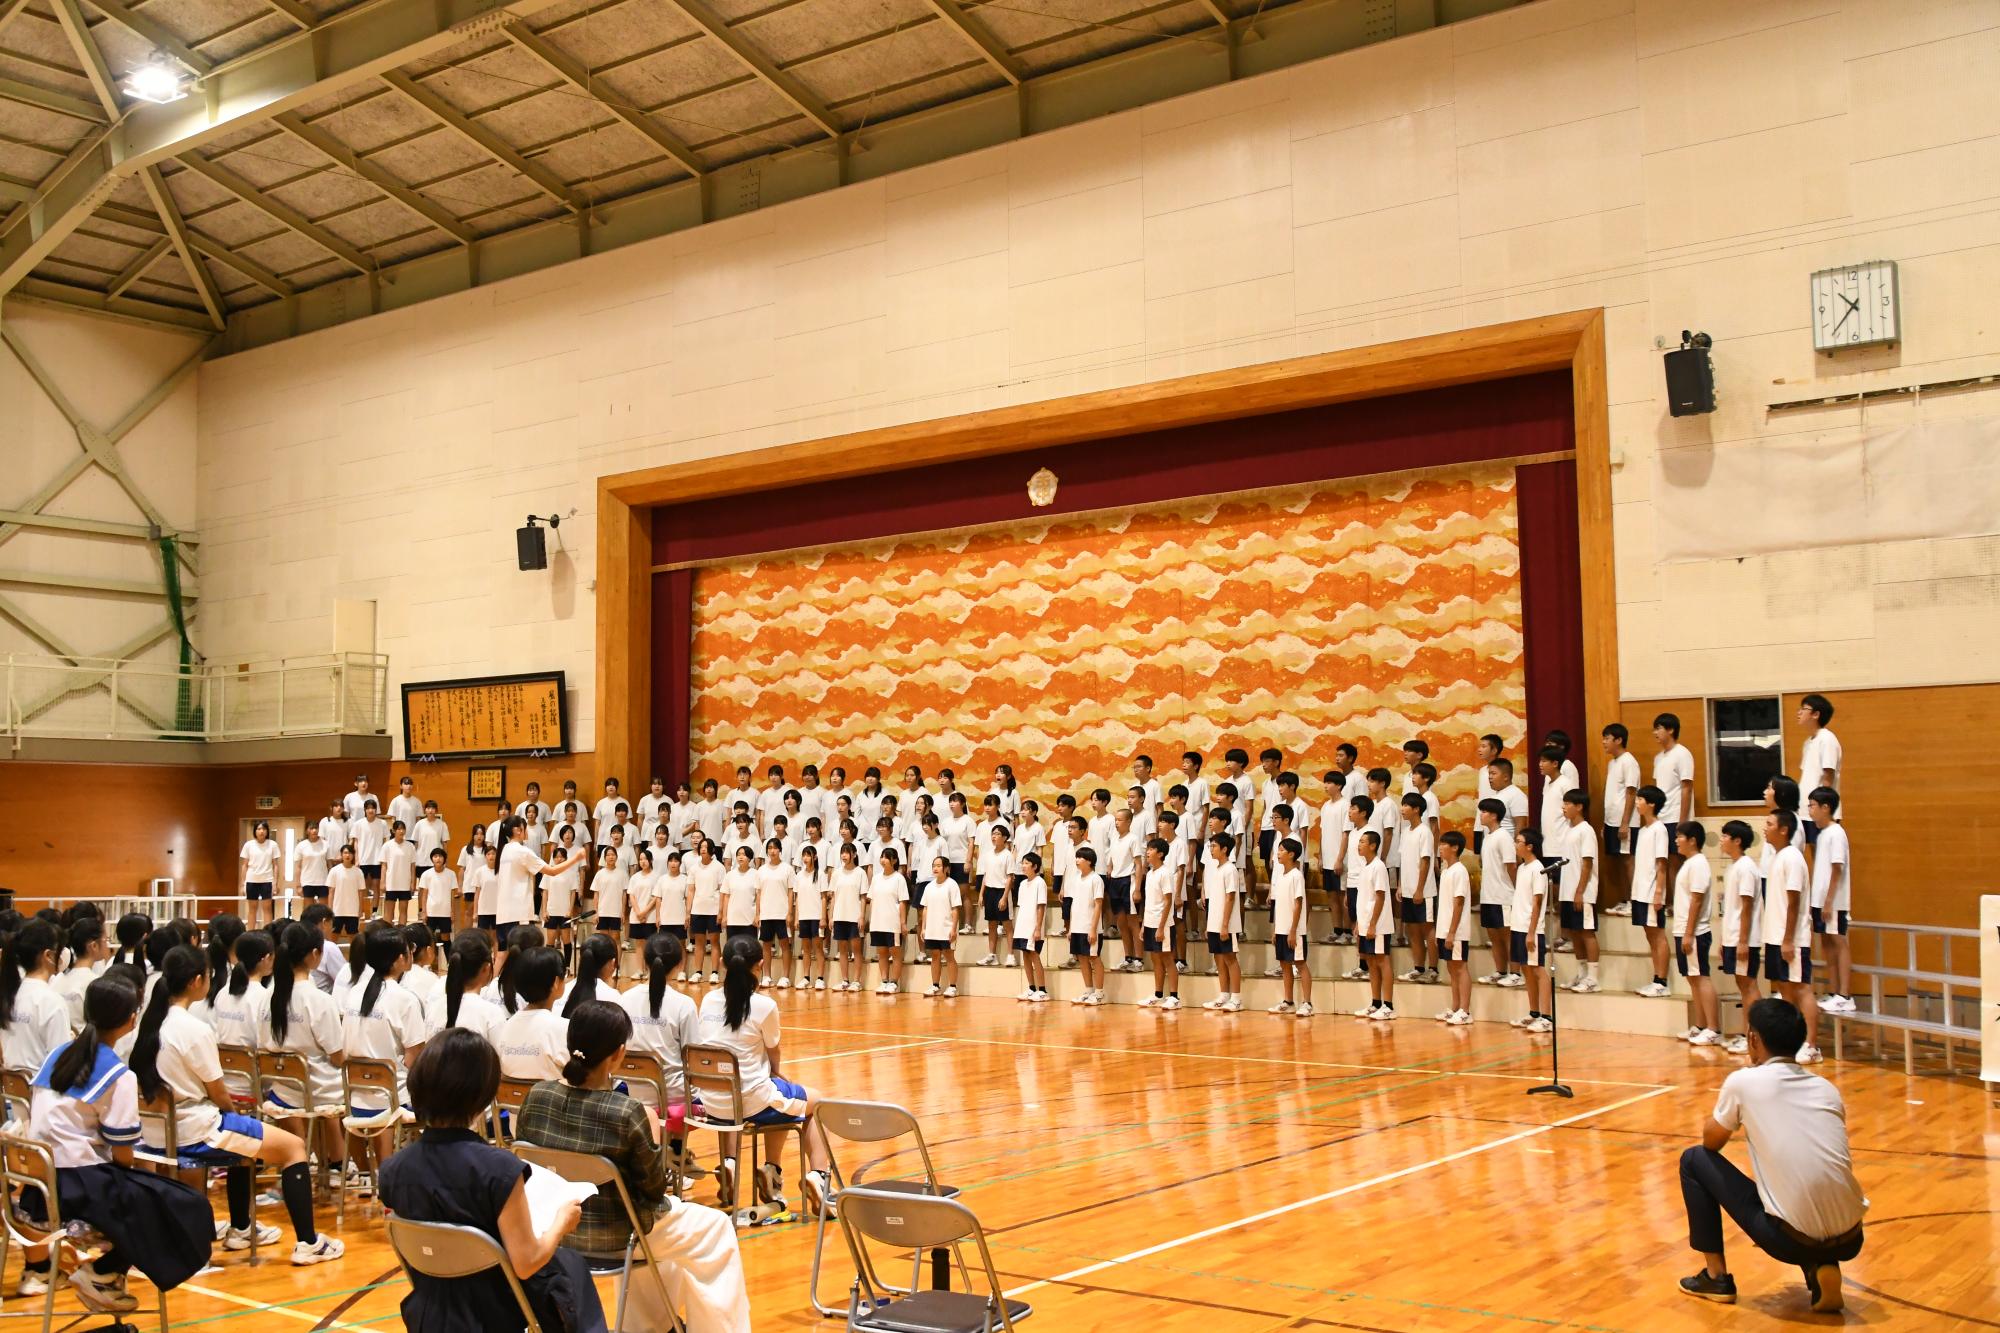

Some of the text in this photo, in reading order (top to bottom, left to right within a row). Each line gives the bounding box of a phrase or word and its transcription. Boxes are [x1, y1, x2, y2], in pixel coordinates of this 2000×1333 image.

[1847, 270, 1857, 281] 12
[1881, 296, 1890, 306] 3
[1819, 305, 1826, 315] 9
[1851, 331, 1860, 341] 6
